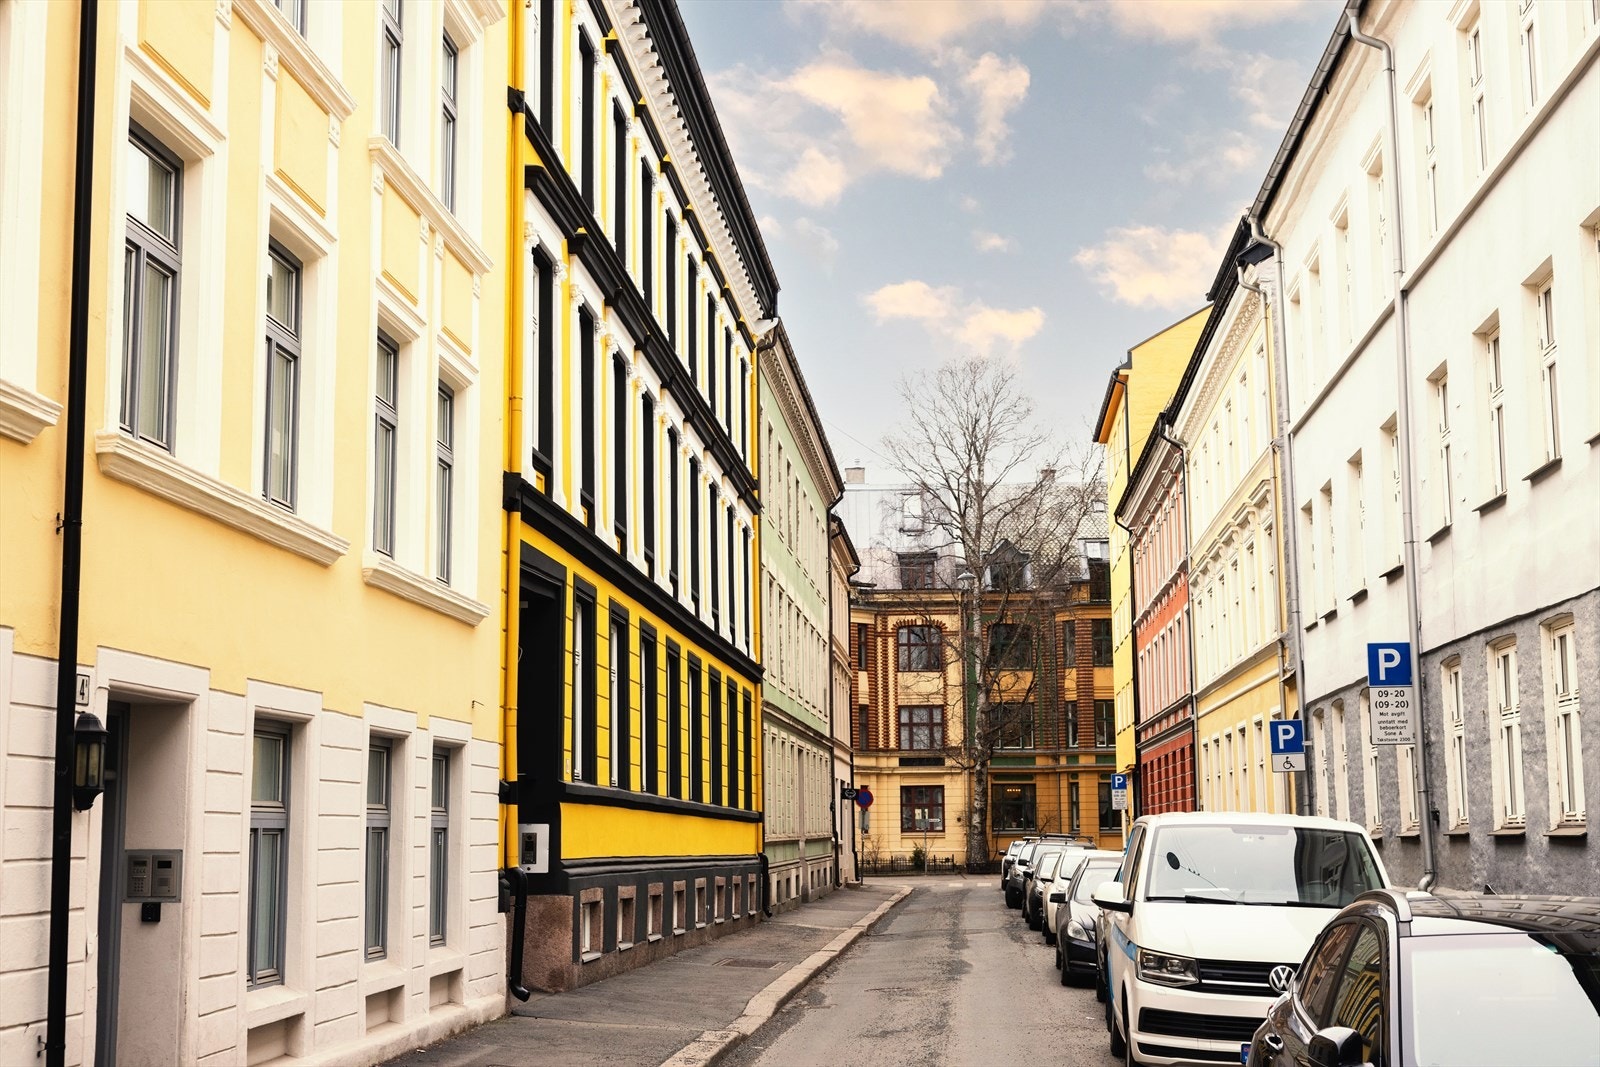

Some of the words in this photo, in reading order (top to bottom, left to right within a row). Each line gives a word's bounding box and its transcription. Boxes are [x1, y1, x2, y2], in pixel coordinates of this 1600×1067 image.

[1378, 648, 1401, 680] P
[1277, 724, 1295, 749] P
[1114, 775, 1124, 788] P
